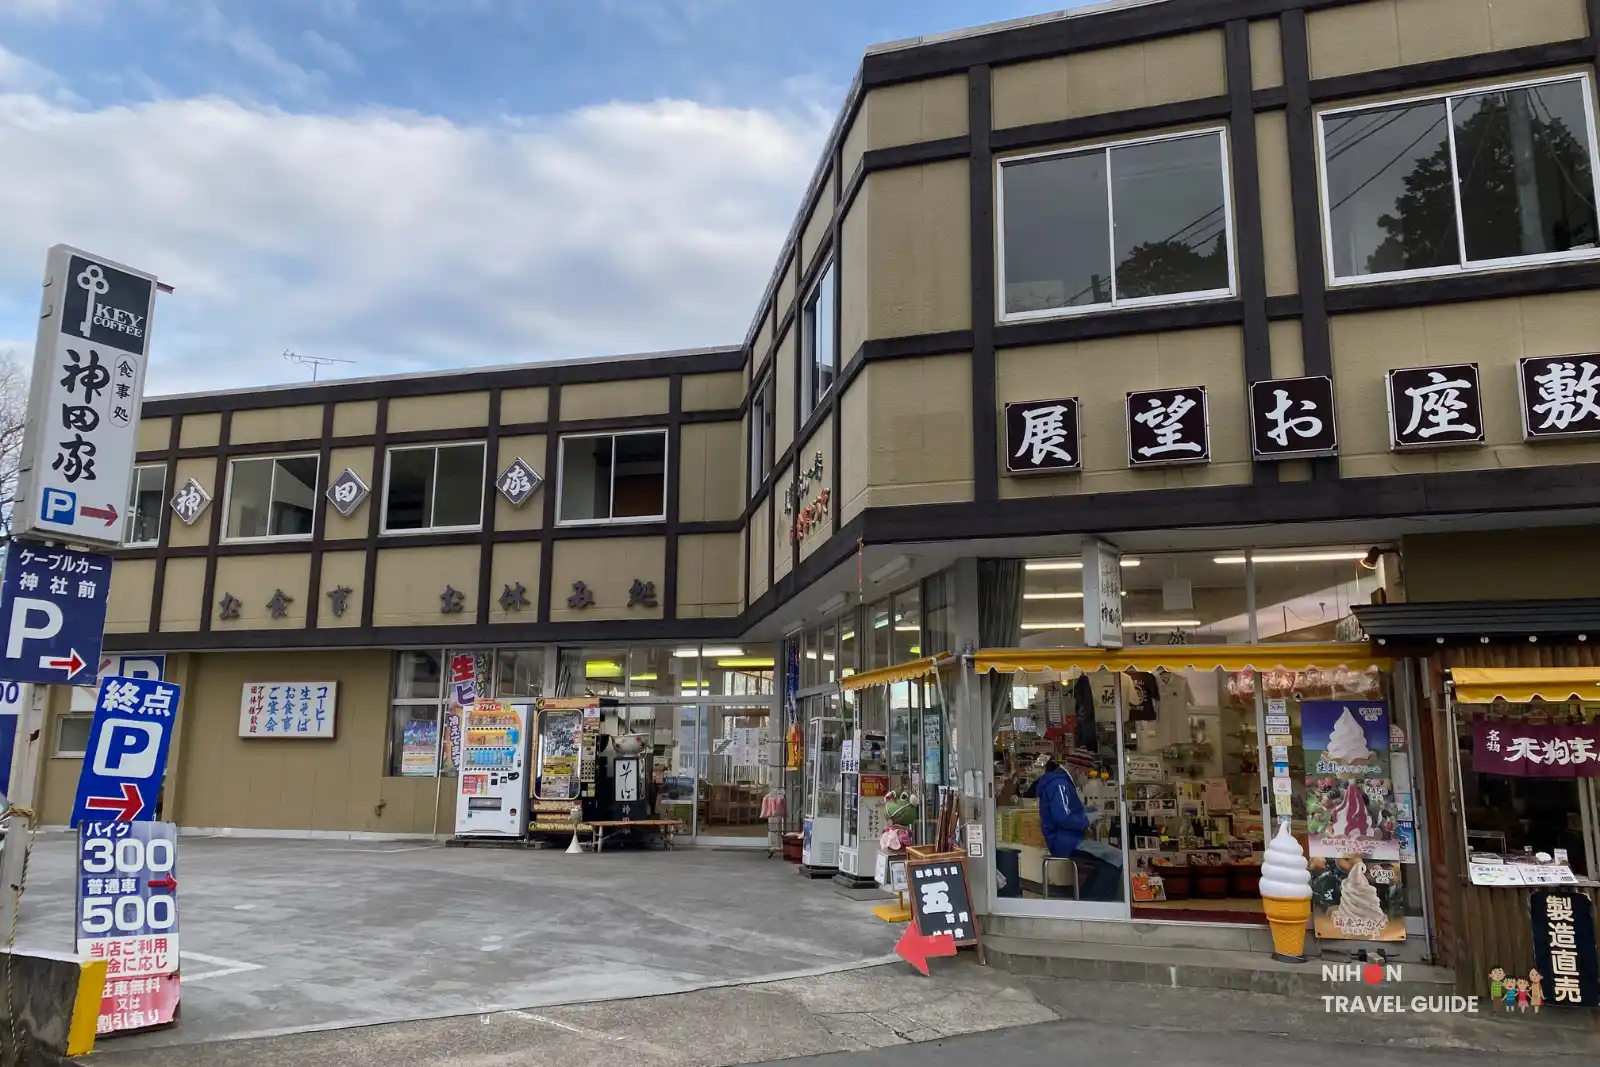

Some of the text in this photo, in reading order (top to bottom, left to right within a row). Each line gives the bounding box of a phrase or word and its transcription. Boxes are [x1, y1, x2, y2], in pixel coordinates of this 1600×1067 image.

[93, 315, 143, 339] COFFEE
[95, 303, 144, 328] KEY
[113, 360, 134, 423] 食事処
[52, 349, 111, 484] 神田家
[46, 491, 74, 520] P
[19, 549, 103, 575] ケーブルカー
[19, 571, 97, 599] 神社前
[6, 597, 64, 659] P
[102, 680, 174, 717] 終点
[264, 686, 280, 732] ご宴会
[281, 686, 296, 732] お食事
[297, 686, 312, 732] 生そば
[316, 686, 328, 732] コーヒー
[104, 726, 150, 769] P
[1486, 729, 1501, 753] 名物
[1504, 737, 1600, 766] 天狗ま
[86, 822, 130, 837] バイク
[83, 838, 175, 873] 300
[87, 878, 137, 894] 普通車
[81, 895, 175, 933] 500
[90, 938, 168, 957] 当店ご利用
[1546, 895, 1582, 1003] 製造直売
[116, 998, 140, 1011] 又は
